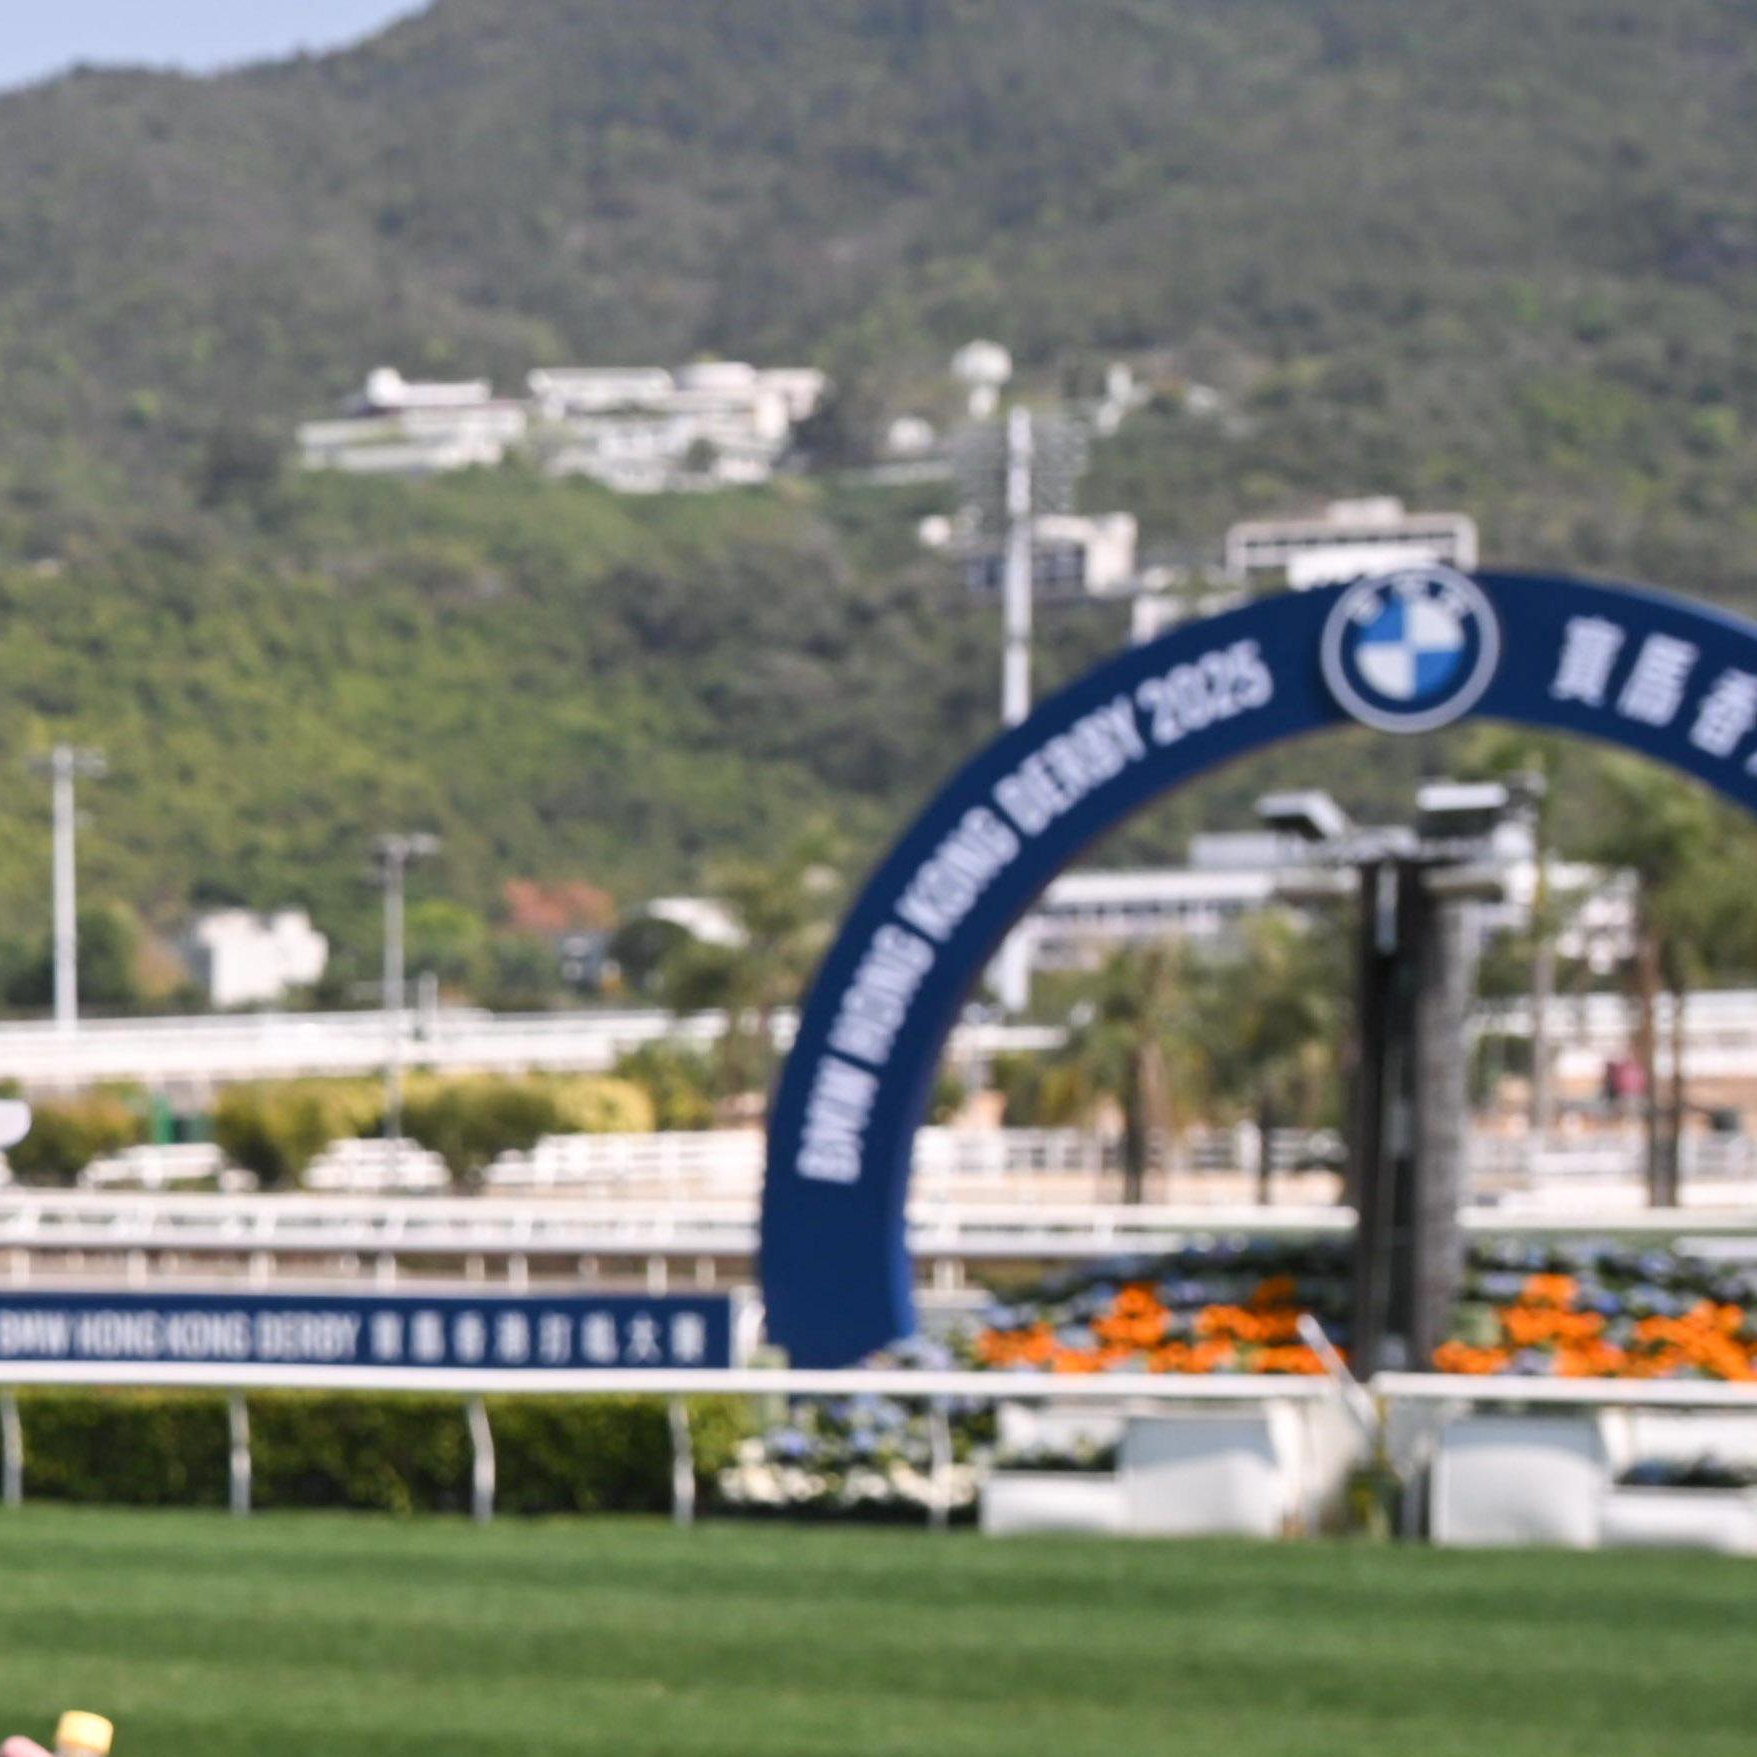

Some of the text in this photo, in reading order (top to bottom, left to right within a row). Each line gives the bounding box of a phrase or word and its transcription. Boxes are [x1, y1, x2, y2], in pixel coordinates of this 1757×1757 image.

[1548, 614, 1757, 778] 寶馬香
[796, 638, 1274, 1184] BMW HONG KONG DERBY 2025
[75, 1309, 165, 1358] HONG
[167, 1309, 251, 1359] KONG
[255, 1310, 361, 1361] DERBY
